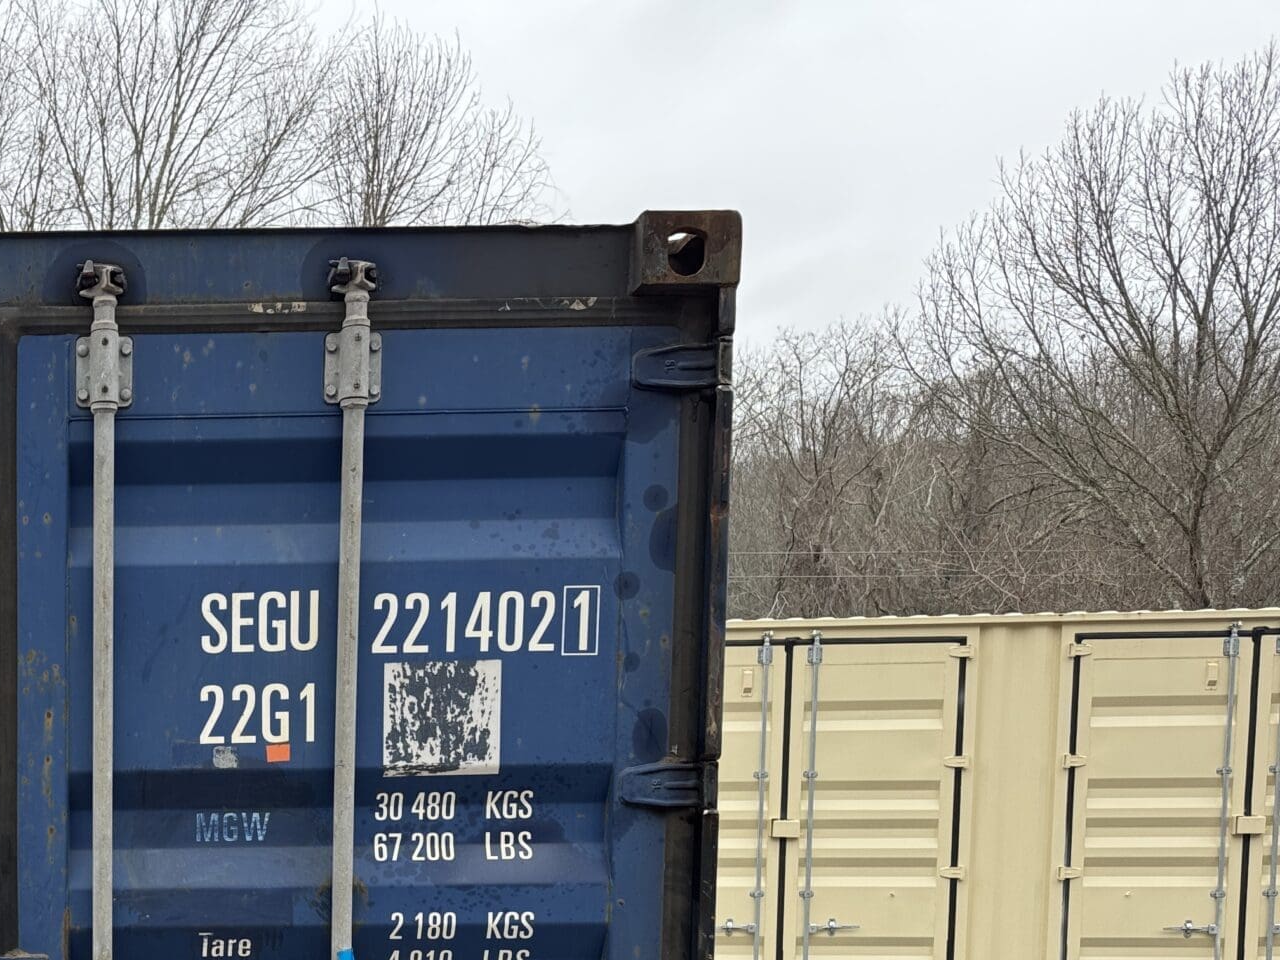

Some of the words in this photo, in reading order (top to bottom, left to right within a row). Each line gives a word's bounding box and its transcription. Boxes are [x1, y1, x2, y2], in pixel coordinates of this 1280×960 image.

[200, 589, 320, 654] SEGU
[199, 682, 316, 746] 22G1
[374, 791, 404, 821] 30
[411, 790, 456, 821] 480
[485, 790, 534, 820] KGS
[195, 811, 270, 843] MGW
[373, 833, 402, 862] 67
[411, 832, 455, 862] 200
[484, 831, 534, 861] LBS
[388, 912, 404, 941] 2
[414, 911, 457, 940] 180
[486, 911, 535, 940] KGS
[199, 932, 252, 959] Tare
